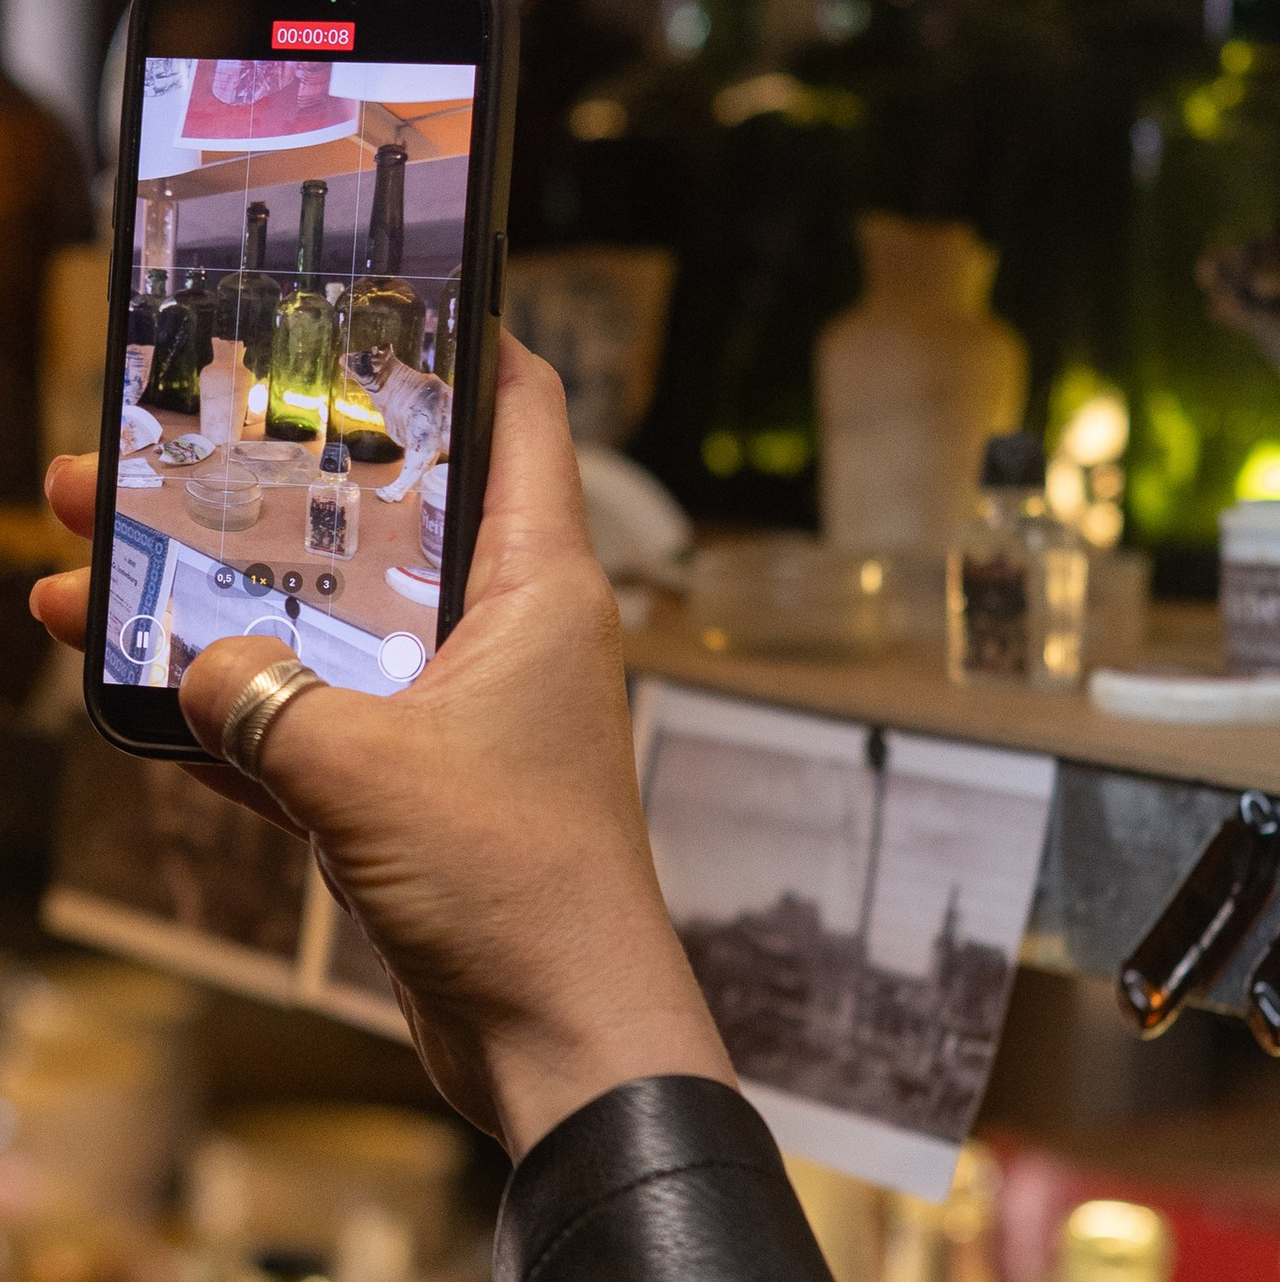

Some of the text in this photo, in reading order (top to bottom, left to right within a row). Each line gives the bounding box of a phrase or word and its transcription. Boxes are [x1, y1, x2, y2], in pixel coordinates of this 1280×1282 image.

[277, 28, 349, 45] 00:00:08
[217, 573, 232, 584] 0,5
[289, 578, 296, 587] 2
[323, 580, 330, 589] 3
